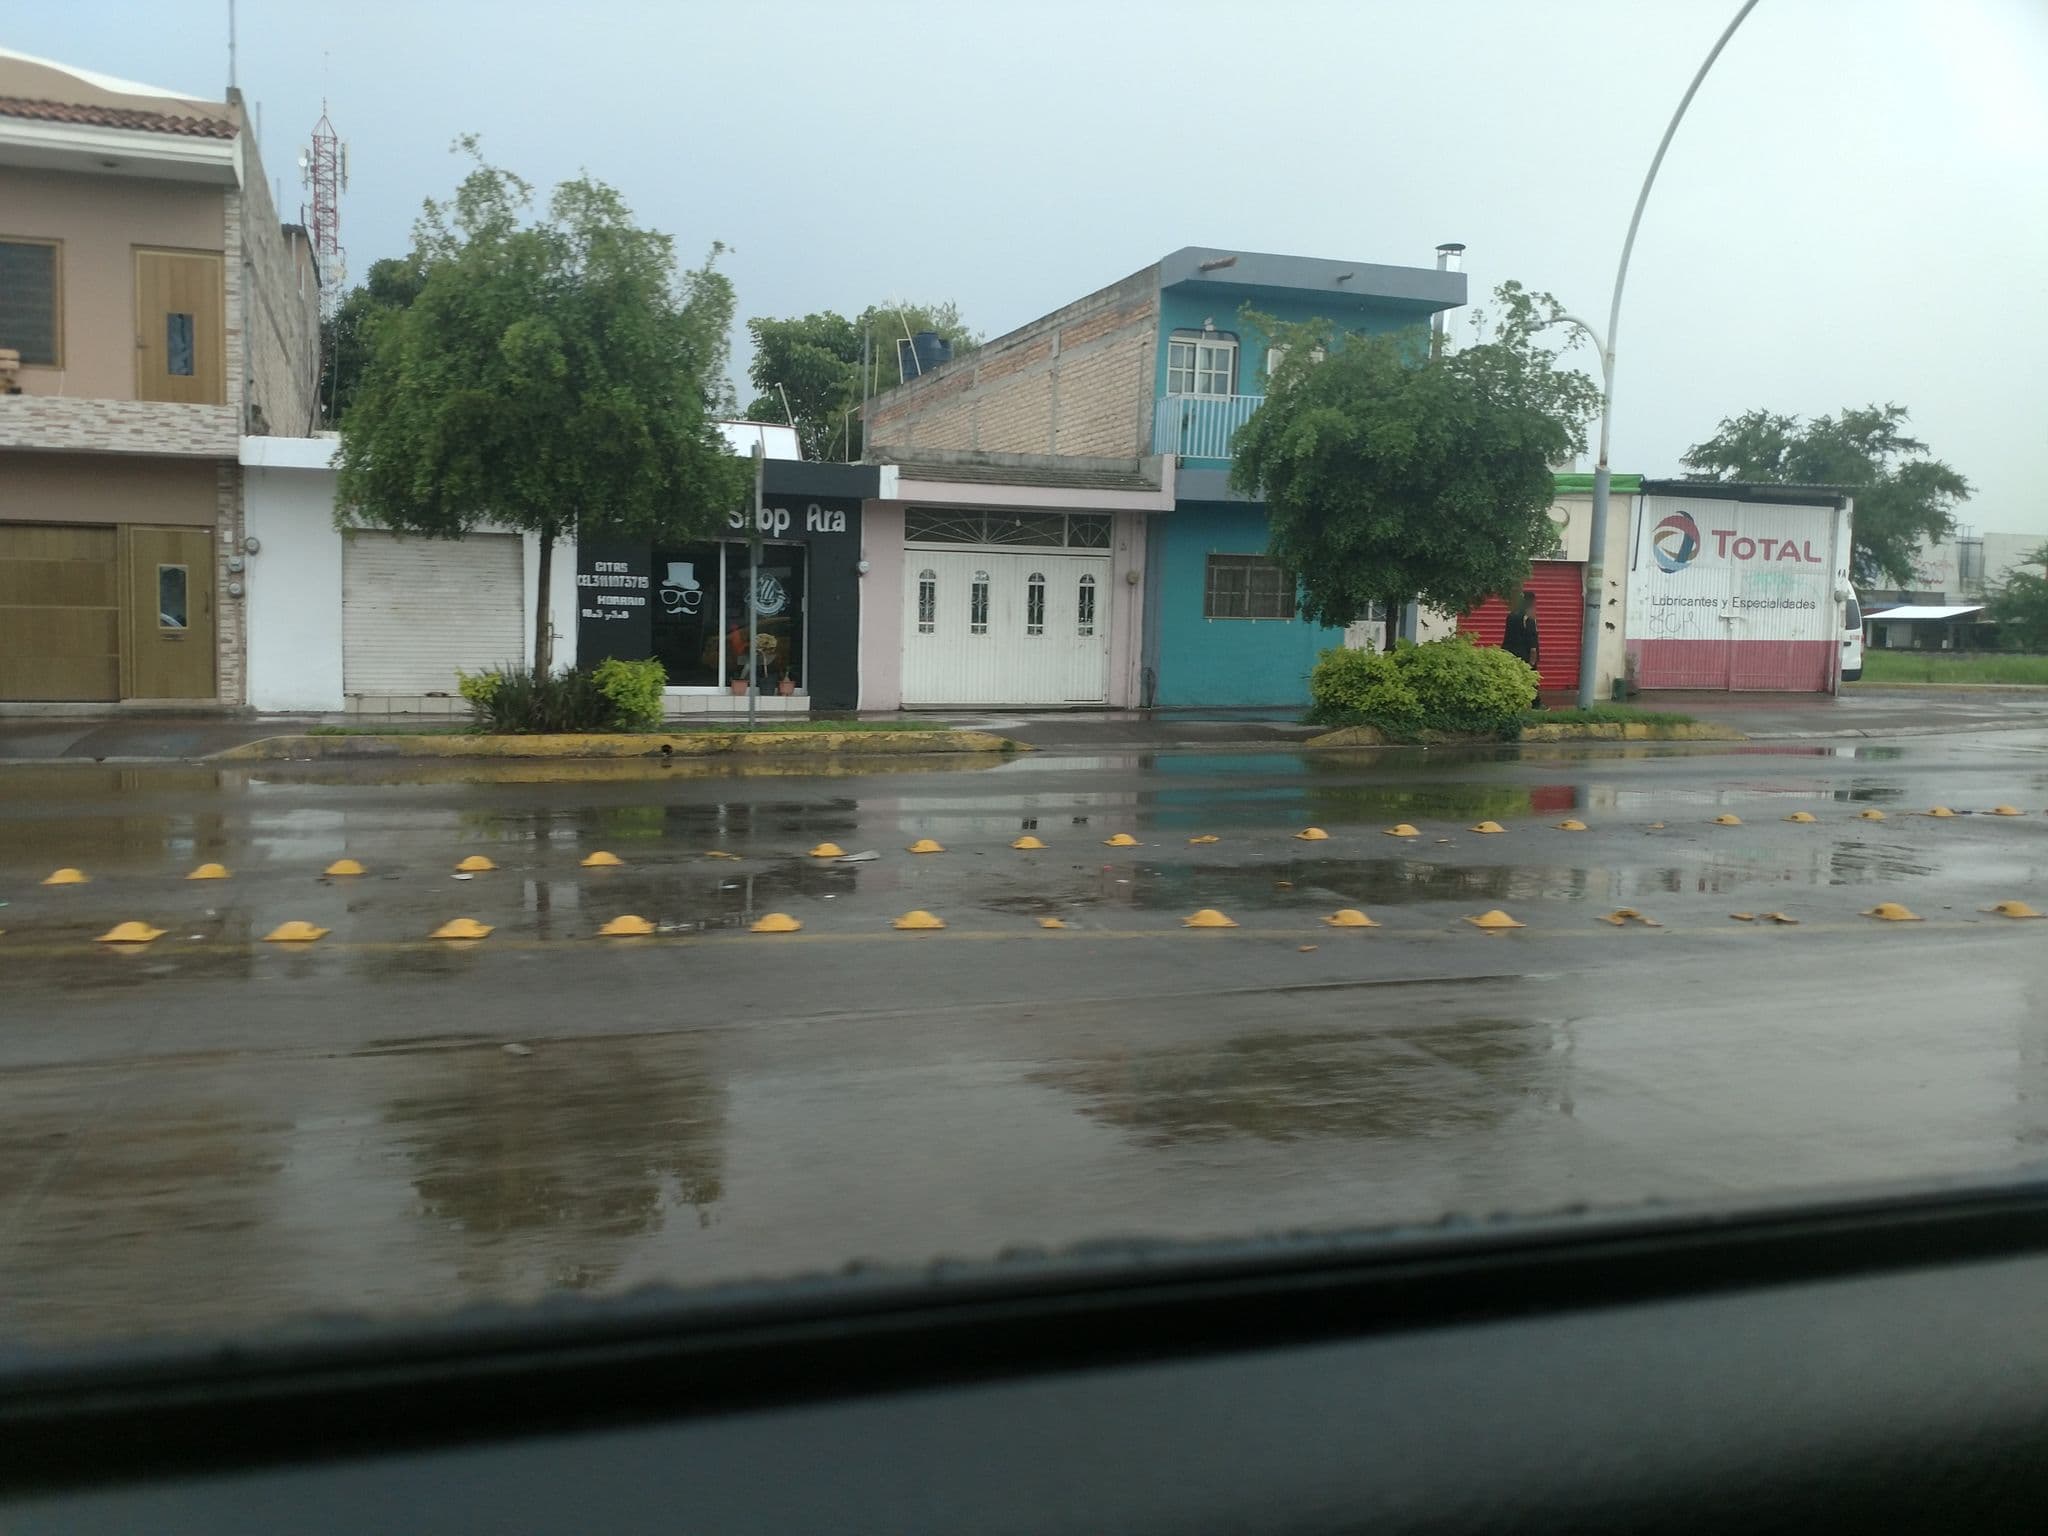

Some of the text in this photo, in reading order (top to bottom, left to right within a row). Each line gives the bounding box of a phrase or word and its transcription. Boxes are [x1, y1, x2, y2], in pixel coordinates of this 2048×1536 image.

[806, 503, 846, 532] Ara
[1711, 529, 1822, 563] TOTAL
[595, 561, 628, 573] CITAS
[1652, 595, 1816, 610] Lubricantes y Especialidades
